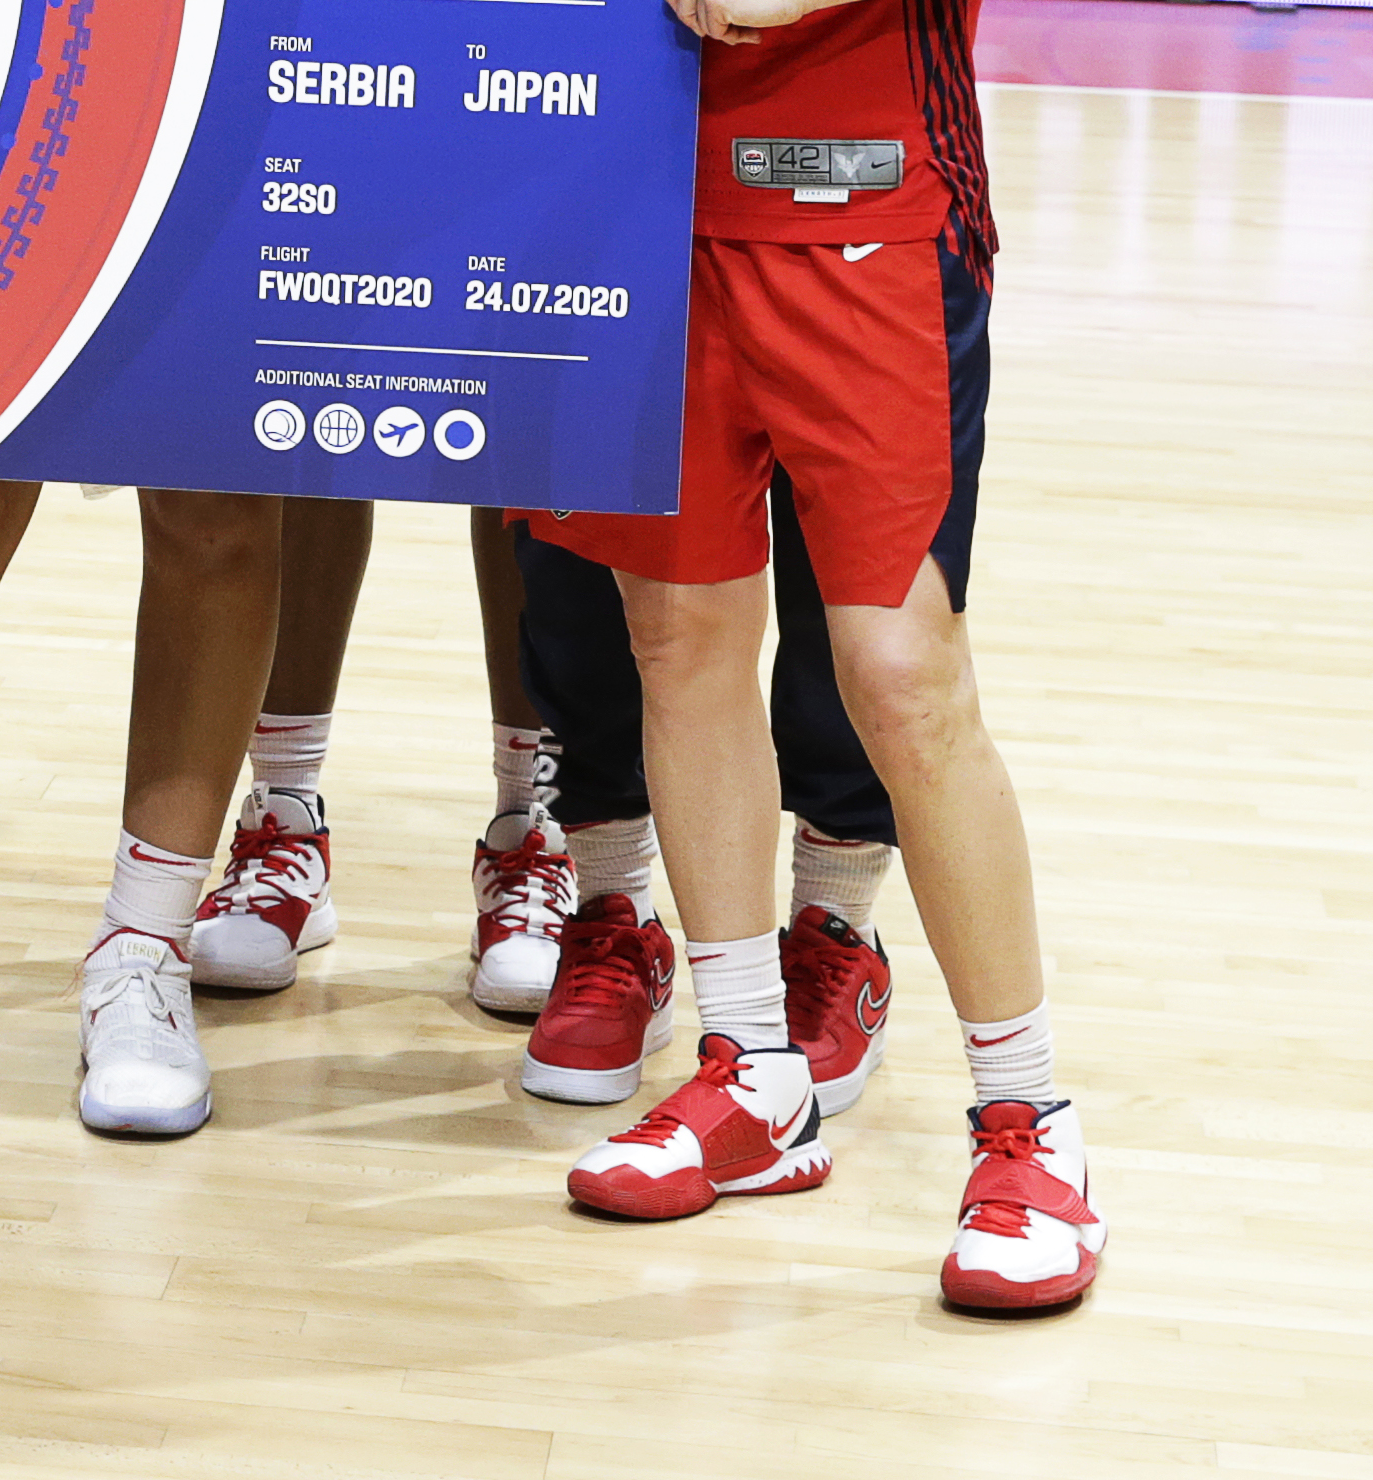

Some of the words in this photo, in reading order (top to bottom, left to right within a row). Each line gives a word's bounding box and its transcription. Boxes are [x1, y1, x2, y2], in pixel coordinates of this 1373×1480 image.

[271, 36, 311, 52] FROM
[466, 45, 485, 59] TO
[269, 60, 414, 108] SERBIA
[464, 70, 597, 116] JAPAN
[265, 158, 301, 173] SEAT
[777, 145, 820, 170] 42
[261, 246, 310, 262] FLIGHT
[469, 256, 505, 271] DATE
[466, 280, 628, 318] 24.07.2020
[255, 369, 343, 387] ADDITIONAL
[346, 374, 382, 389] SEAT
[386, 376, 486, 395] INFORMATION
[120, 940, 162, 961] LEBRON
